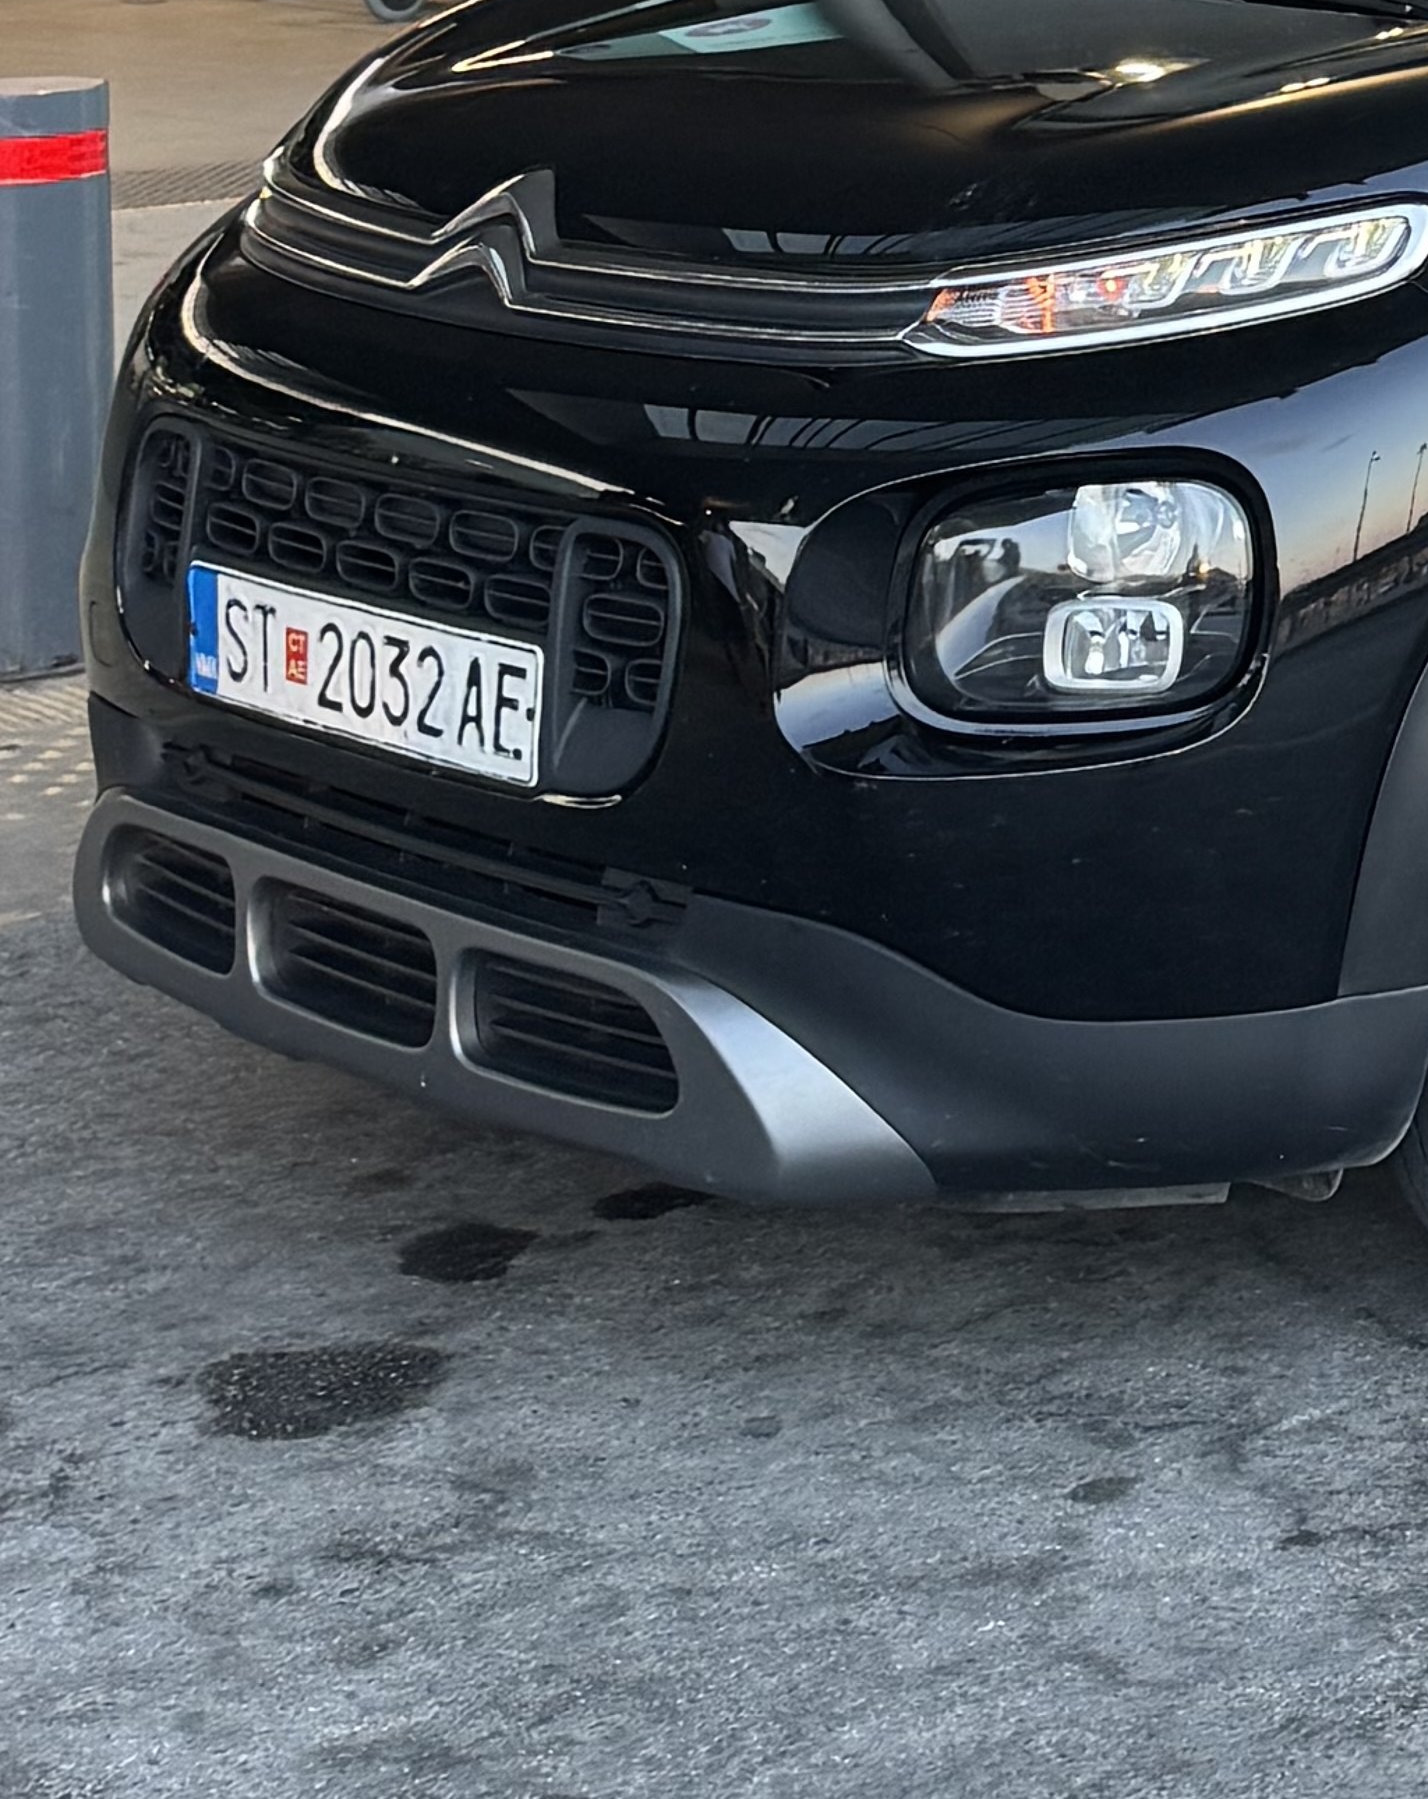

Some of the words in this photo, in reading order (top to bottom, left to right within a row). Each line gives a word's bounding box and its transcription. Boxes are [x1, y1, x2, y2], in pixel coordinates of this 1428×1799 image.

[226, 598, 277, 693] ST
[317, 621, 446, 738] 2032
[457, 656, 528, 761] AE
